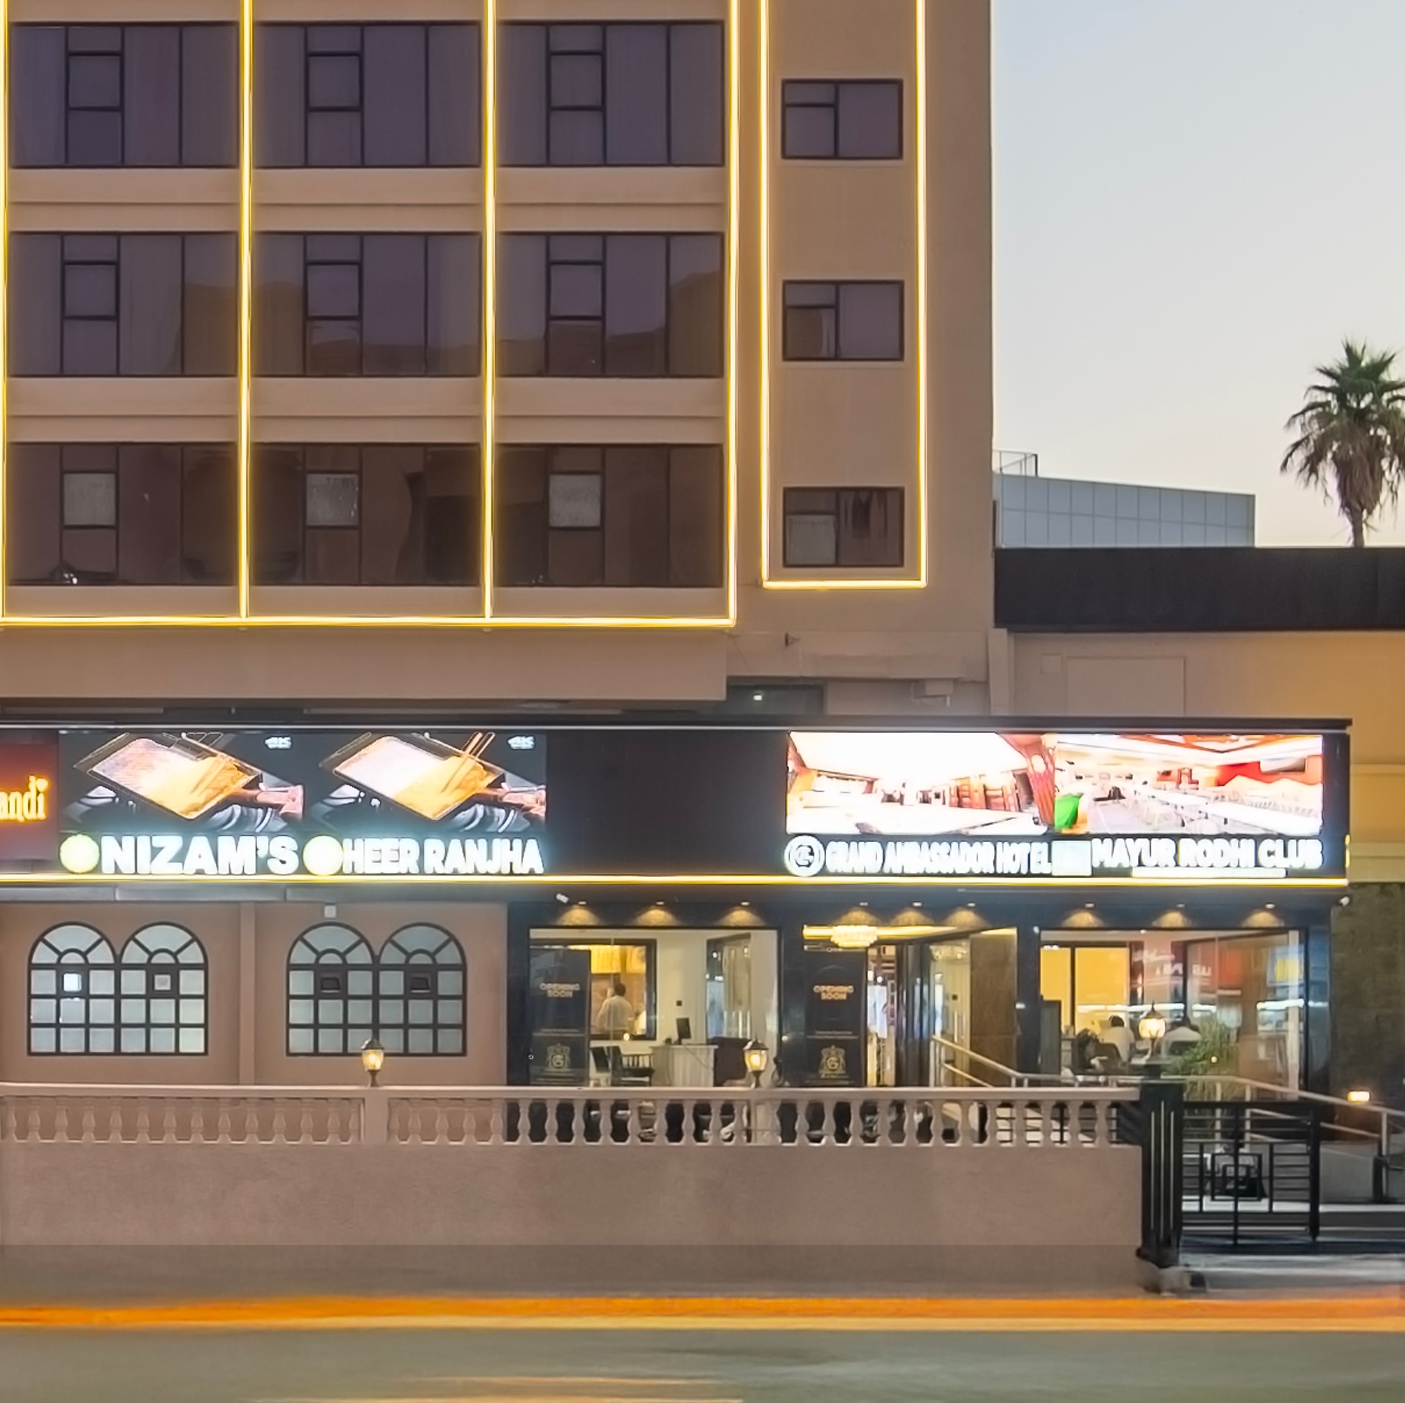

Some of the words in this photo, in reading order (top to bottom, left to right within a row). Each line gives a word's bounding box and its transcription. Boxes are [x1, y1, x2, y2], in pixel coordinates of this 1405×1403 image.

[99, 835, 300, 875] NIZAM'S
[341, 838, 420, 875] HEER
[423, 837, 544, 875] RANJHA
[884, 841, 995, 875] AMBASSADOR
[1092, 837, 1177, 869] MAYUR
[1258, 838, 1323, 870] CLUB
